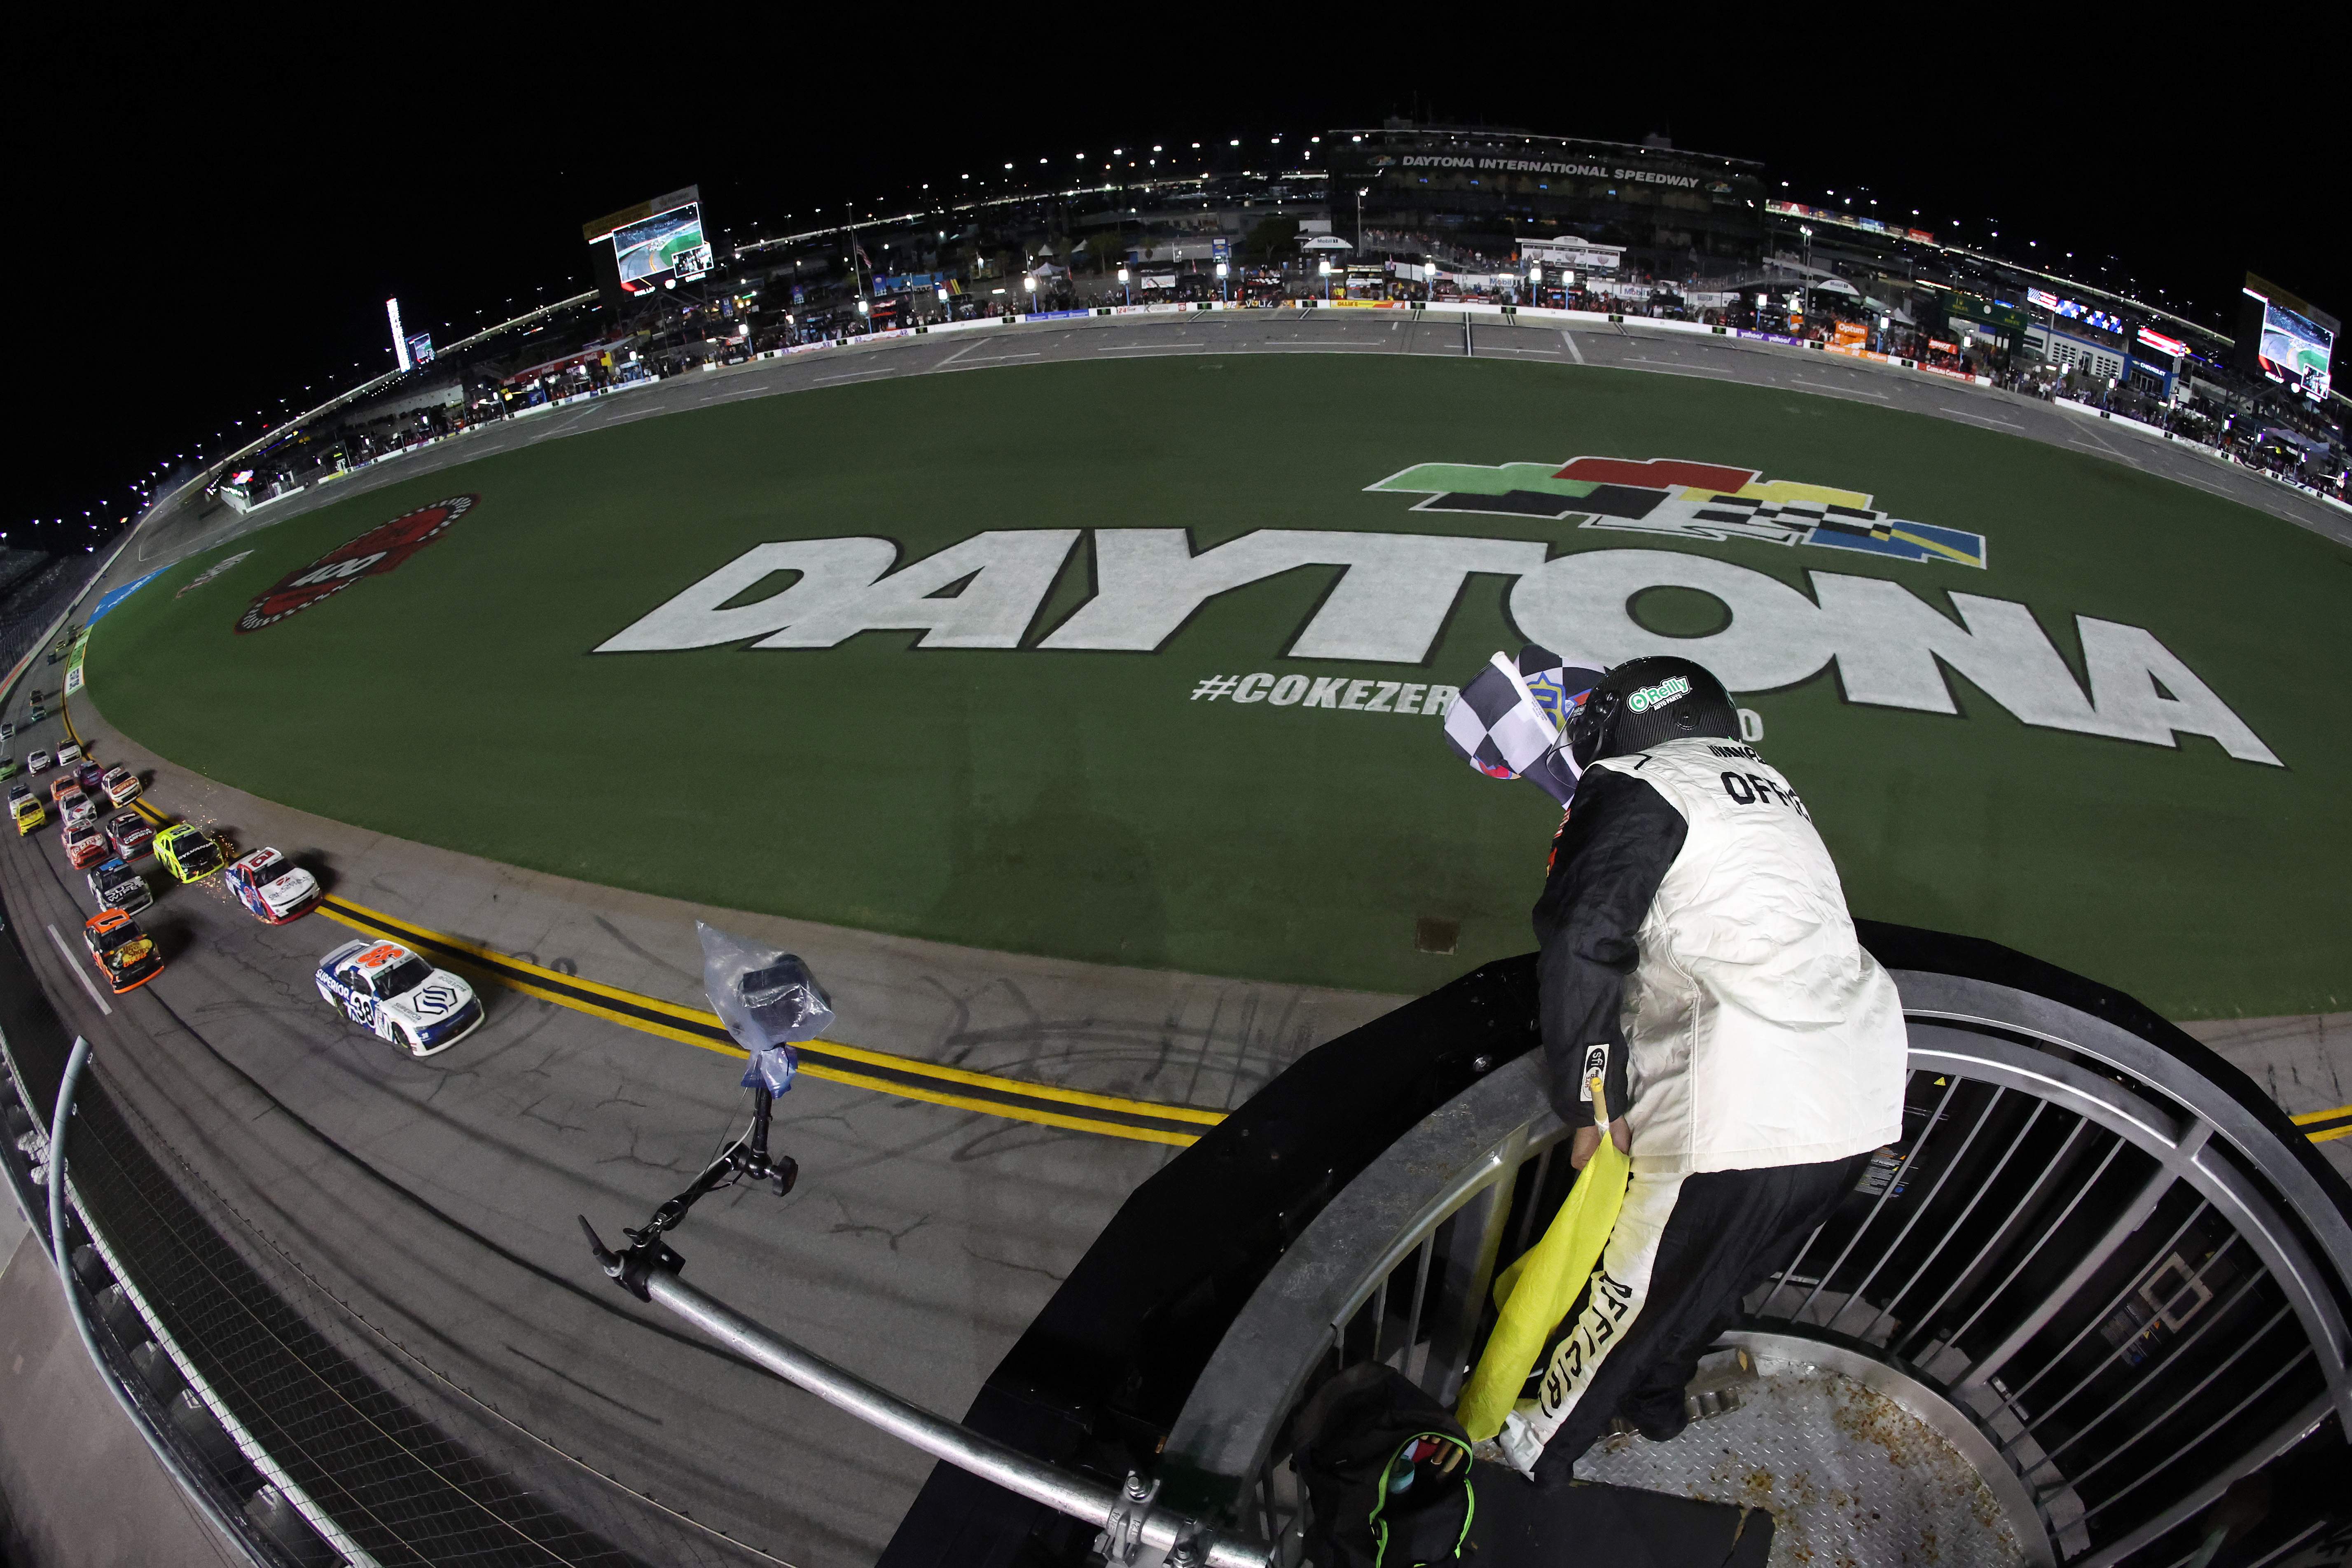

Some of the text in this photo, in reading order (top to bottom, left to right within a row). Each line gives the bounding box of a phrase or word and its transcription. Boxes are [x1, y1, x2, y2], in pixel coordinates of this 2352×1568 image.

[1403, 156, 1699, 188] DAYTONA INTERNATIONAL SPEEDWAY
[1838, 323, 1865, 334] Optum
[592, 528, 2285, 767] DAYTONA
[1630, 678, 1687, 710] O'Reilly
[1653, 694, 1683, 711] AUTO PARTS
[178, 842, 214, 860] SYLVANIA
[355, 944, 405, 968] 38
[315, 968, 350, 1000] SUPERIOR
[354, 997, 375, 1026] 38
[394, 1002, 422, 1021] SUPERIOR
[1592, 1051, 1603, 1067] sfi
